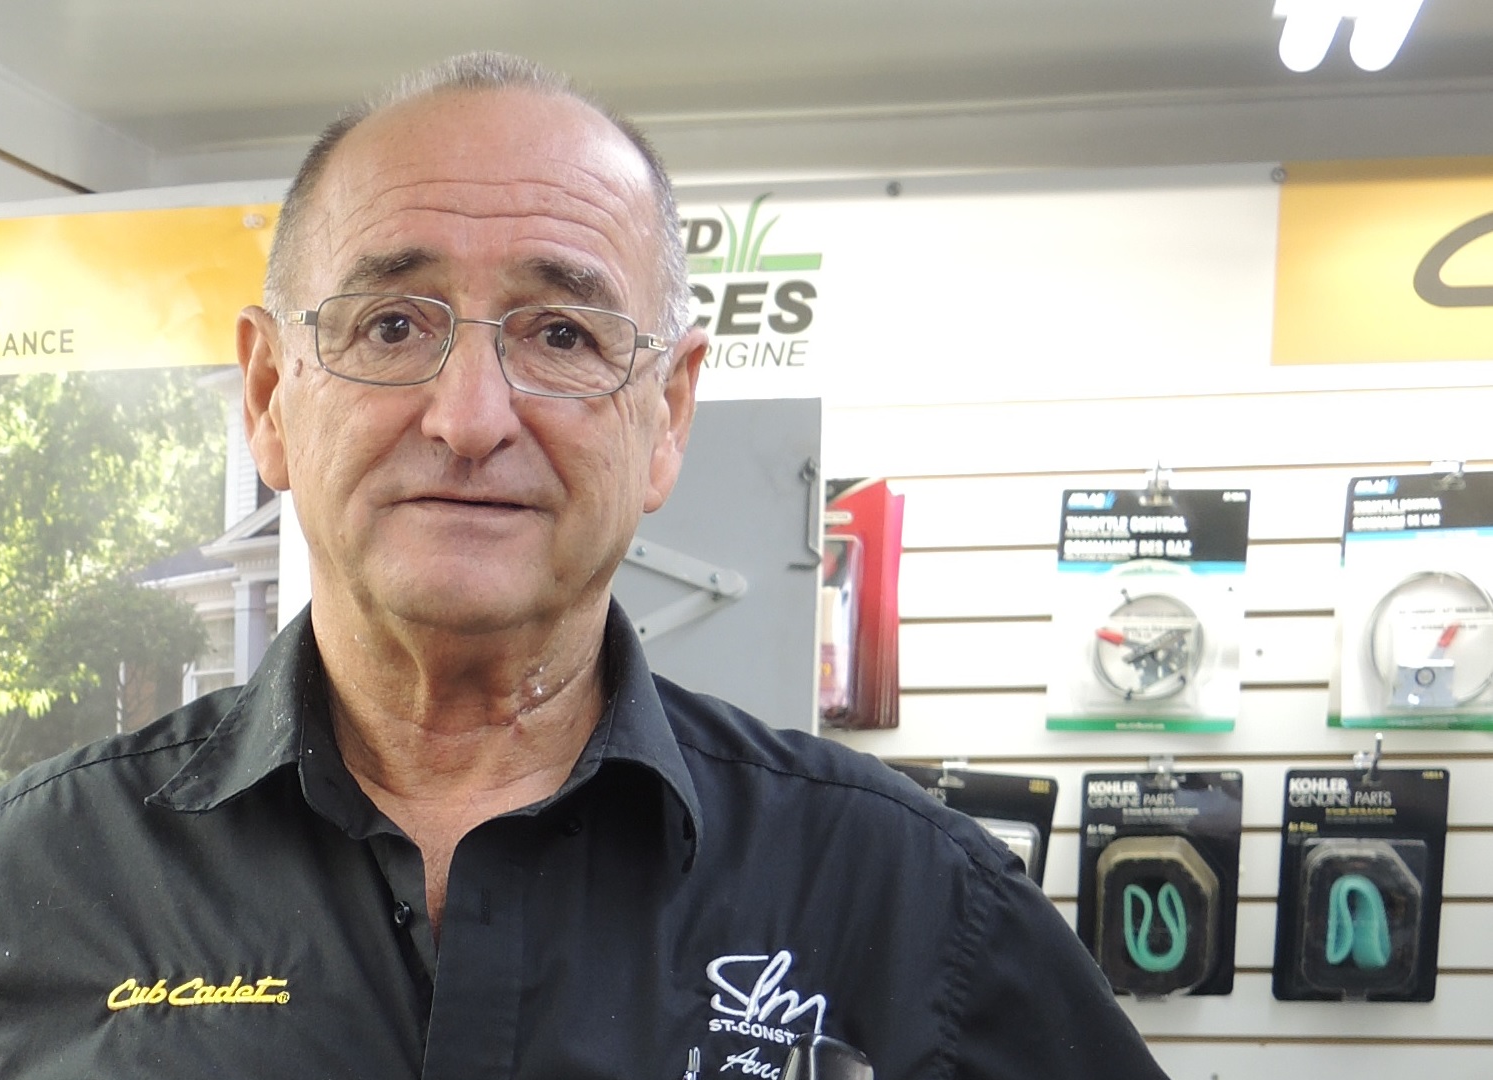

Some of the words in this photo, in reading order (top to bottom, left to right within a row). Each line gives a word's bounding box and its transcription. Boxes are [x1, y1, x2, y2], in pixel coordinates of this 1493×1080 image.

[1088, 780, 1138, 794] KOHLER
[1289, 777, 1349, 792] KOHLER
[1143, 793, 1175, 807] PARTS
[1354, 791, 1392, 806] PARTS
[107, 977, 168, 1012] Cub
[168, 975, 289, 1006] Cadet
